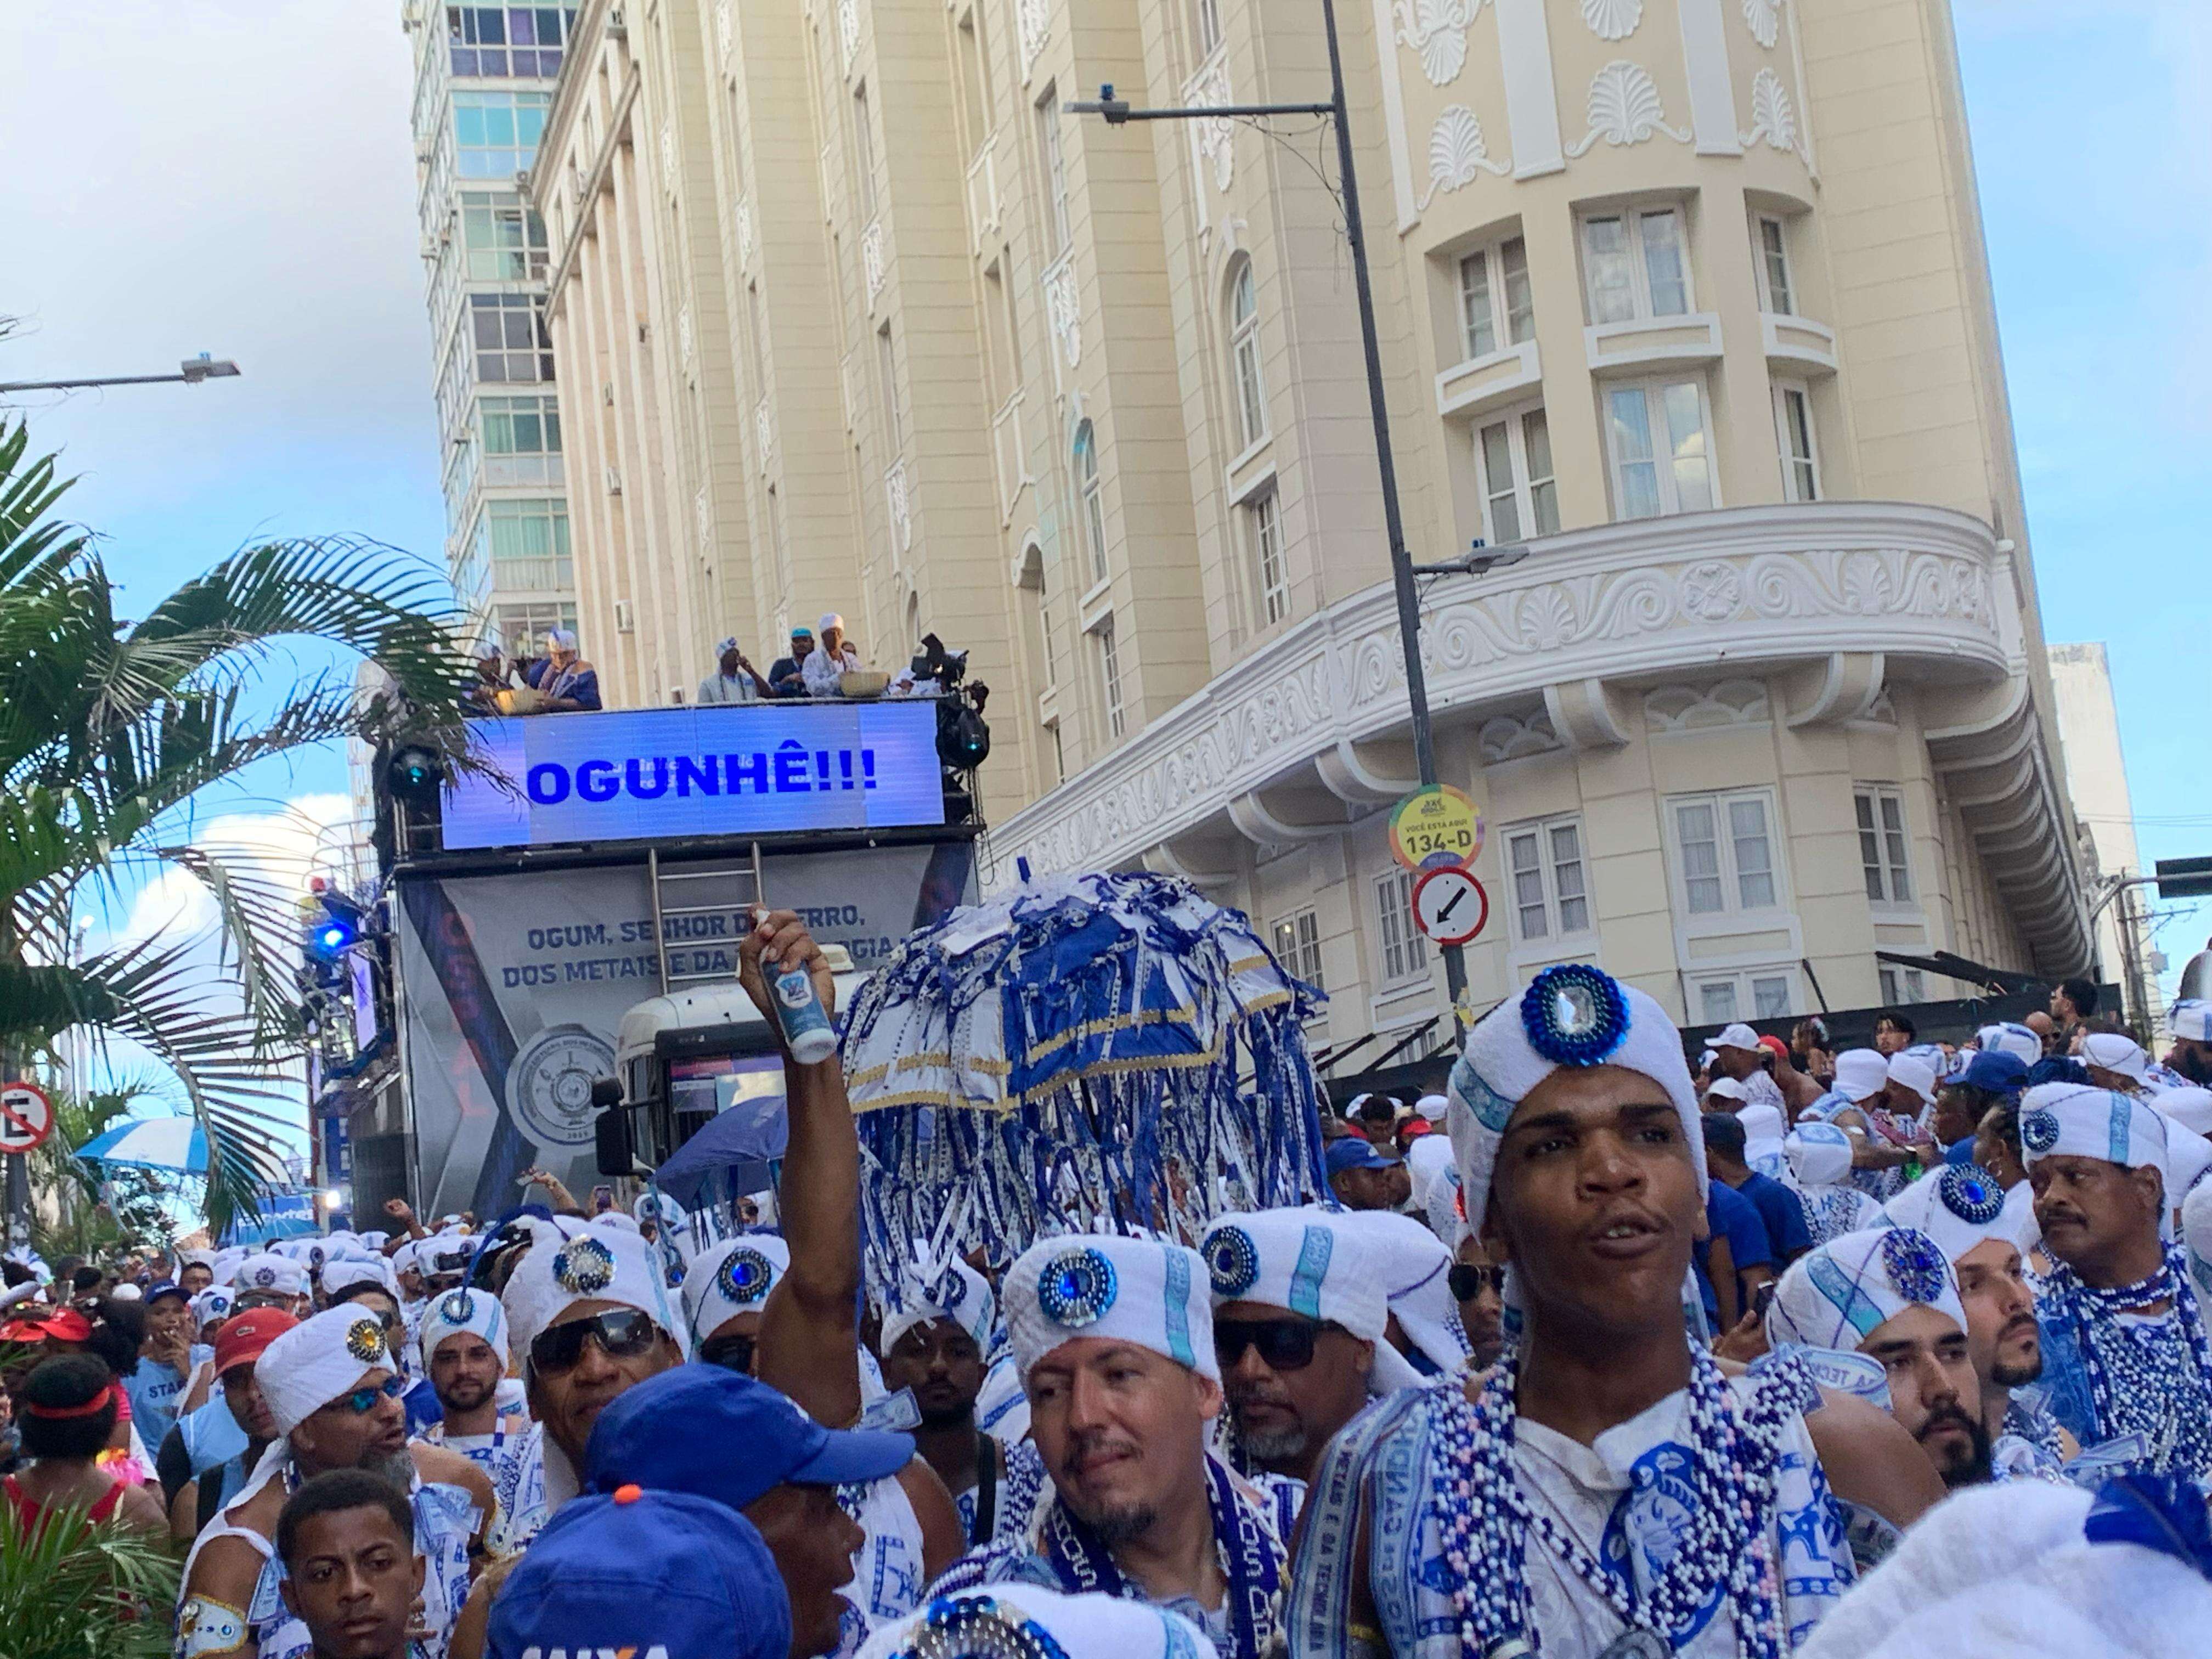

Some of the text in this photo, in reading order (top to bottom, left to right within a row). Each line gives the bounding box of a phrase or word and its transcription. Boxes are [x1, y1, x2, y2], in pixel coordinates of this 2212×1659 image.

[527, 738, 876, 805] OGUNHÊ!!!
[1406, 830, 1472, 854] 134-D
[528, 923, 613, 950] OGUM,
[732, 913, 750, 934] D
[503, 963, 557, 988] DOS
[564, 954, 659, 982] METAIS
[669, 953, 686, 974] E
[692, 950, 729, 972] DA
[4, 1098, 30, 1137] E
